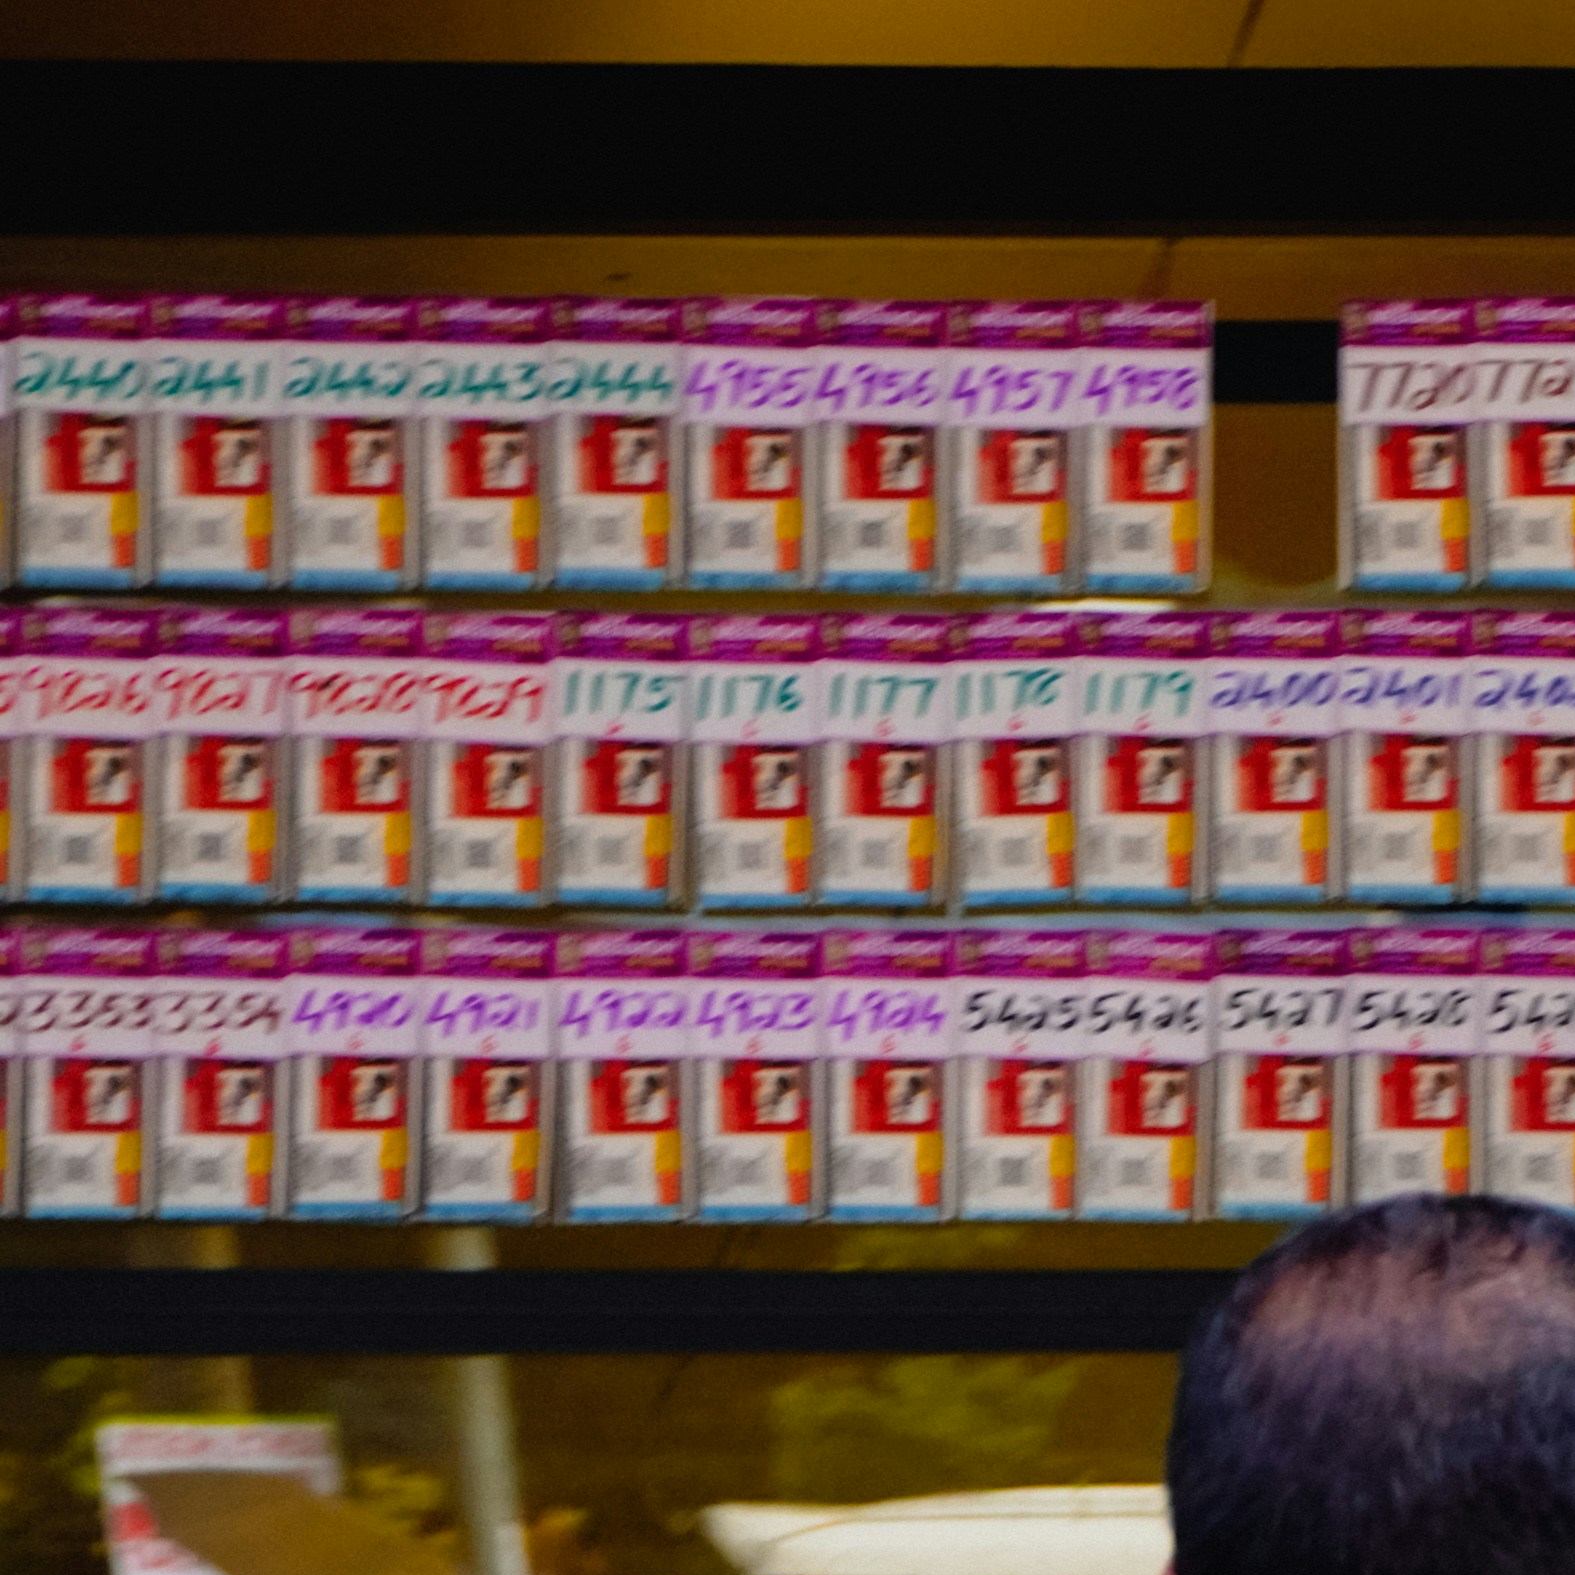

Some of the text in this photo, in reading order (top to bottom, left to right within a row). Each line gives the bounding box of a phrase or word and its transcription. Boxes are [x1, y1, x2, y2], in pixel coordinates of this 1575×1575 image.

[151, 355, 270, 401] 2441
[286, 355, 411, 401] 2442
[417, 358, 543, 401] 2443
[546, 356, 676, 402] 2444
[683, 359, 813, 411] 4955
[816, 361, 937, 412] 4956
[950, 363, 1073, 416] 4957
[1081, 364, 1199, 416] 4958
[1347, 360, 1473, 410] 7720
[564, 669, 687, 714] 1175
[699, 671, 801, 720] 1176
[827, 672, 940, 720] 1177
[955, 668, 1066, 719] 1178
[1083, 669, 1195, 719] 1179
[1211, 670, 1340, 710] 2400
[1342, 667, 1464, 711] 2401
[425, 990, 540, 1038] 4921
[698, 989, 813, 1039] 4923
[827, 991, 947, 1040] 4924
[961, 989, 1085, 1032] 5425
[1089, 992, 1206, 1033] 5426
[1222, 987, 1343, 1031] 5427
[1352, 988, 1468, 1032] 5428
